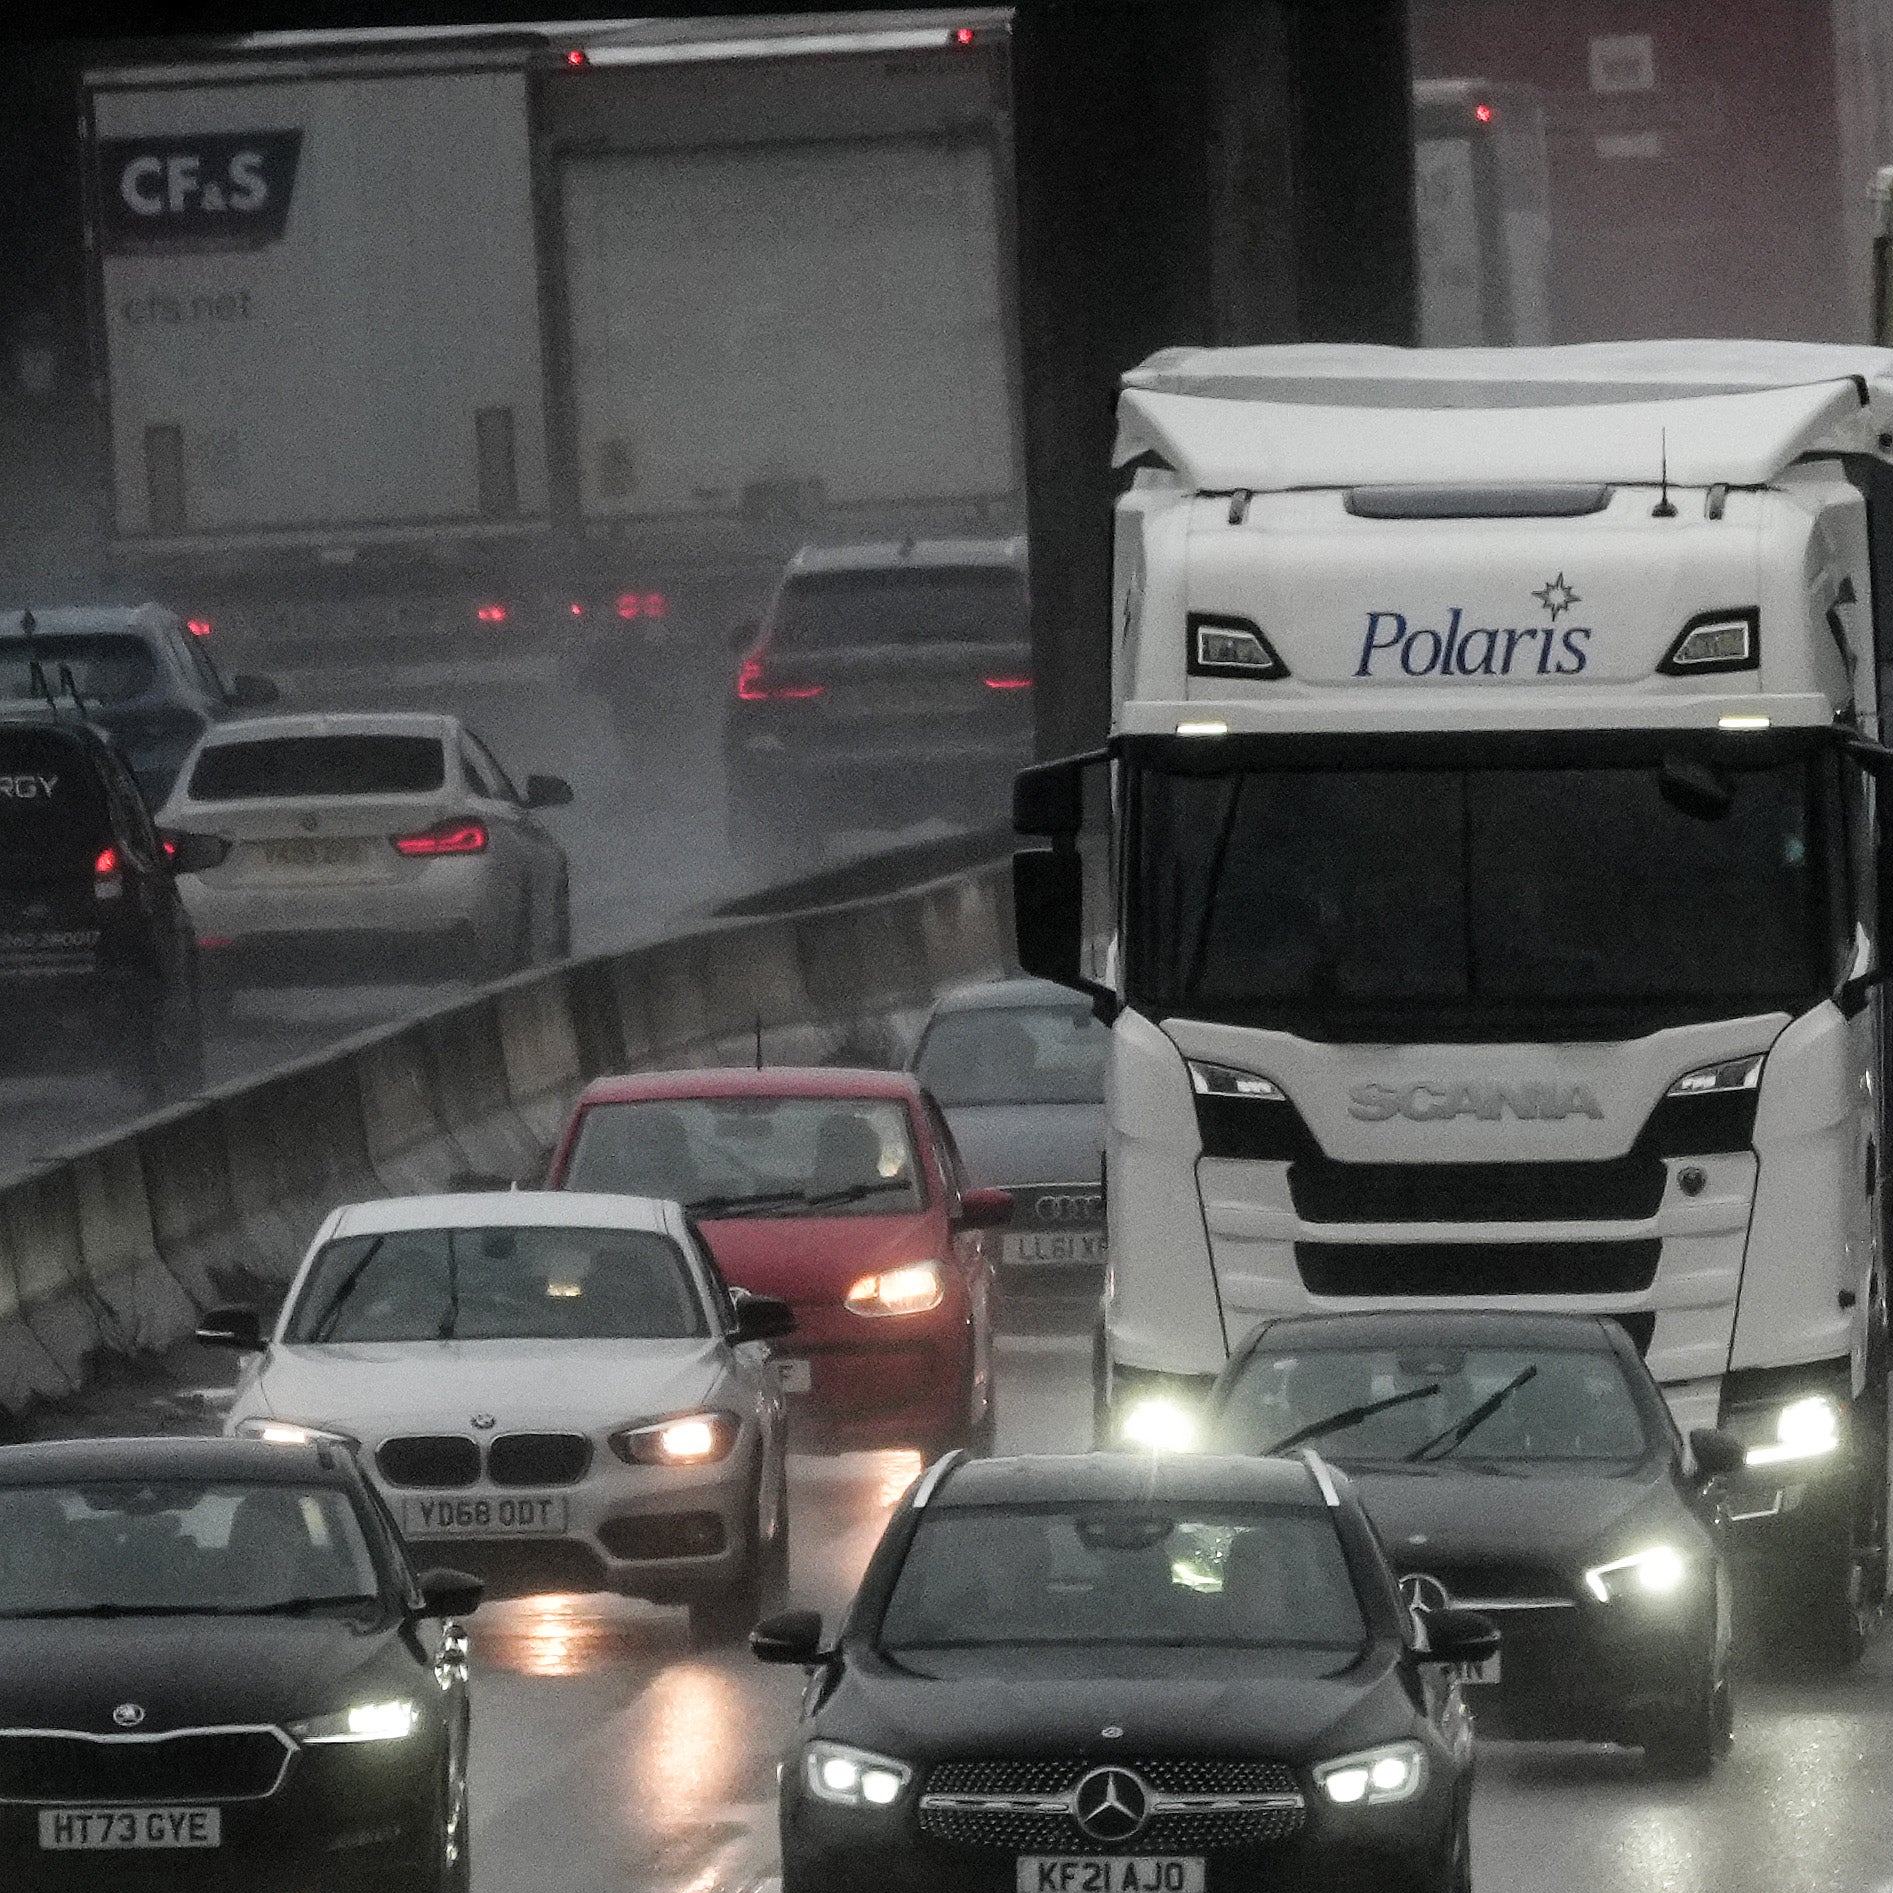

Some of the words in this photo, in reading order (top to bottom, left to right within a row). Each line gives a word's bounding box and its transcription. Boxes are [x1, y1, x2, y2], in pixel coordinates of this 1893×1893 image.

[121, 152, 268, 216] CF&S
[1353, 607, 1593, 677] Polaris
[1347, 1082, 1605, 1122] SCANIA
[420, 1499, 491, 1527] YD68
[498, 1499, 553, 1526] ODT
[54, 1813, 137, 1843] HT73
[146, 1812, 208, 1842] GYE
[1038, 1861, 1111, 1893] KF21
[1121, 1861, 1184, 1893] AJO
